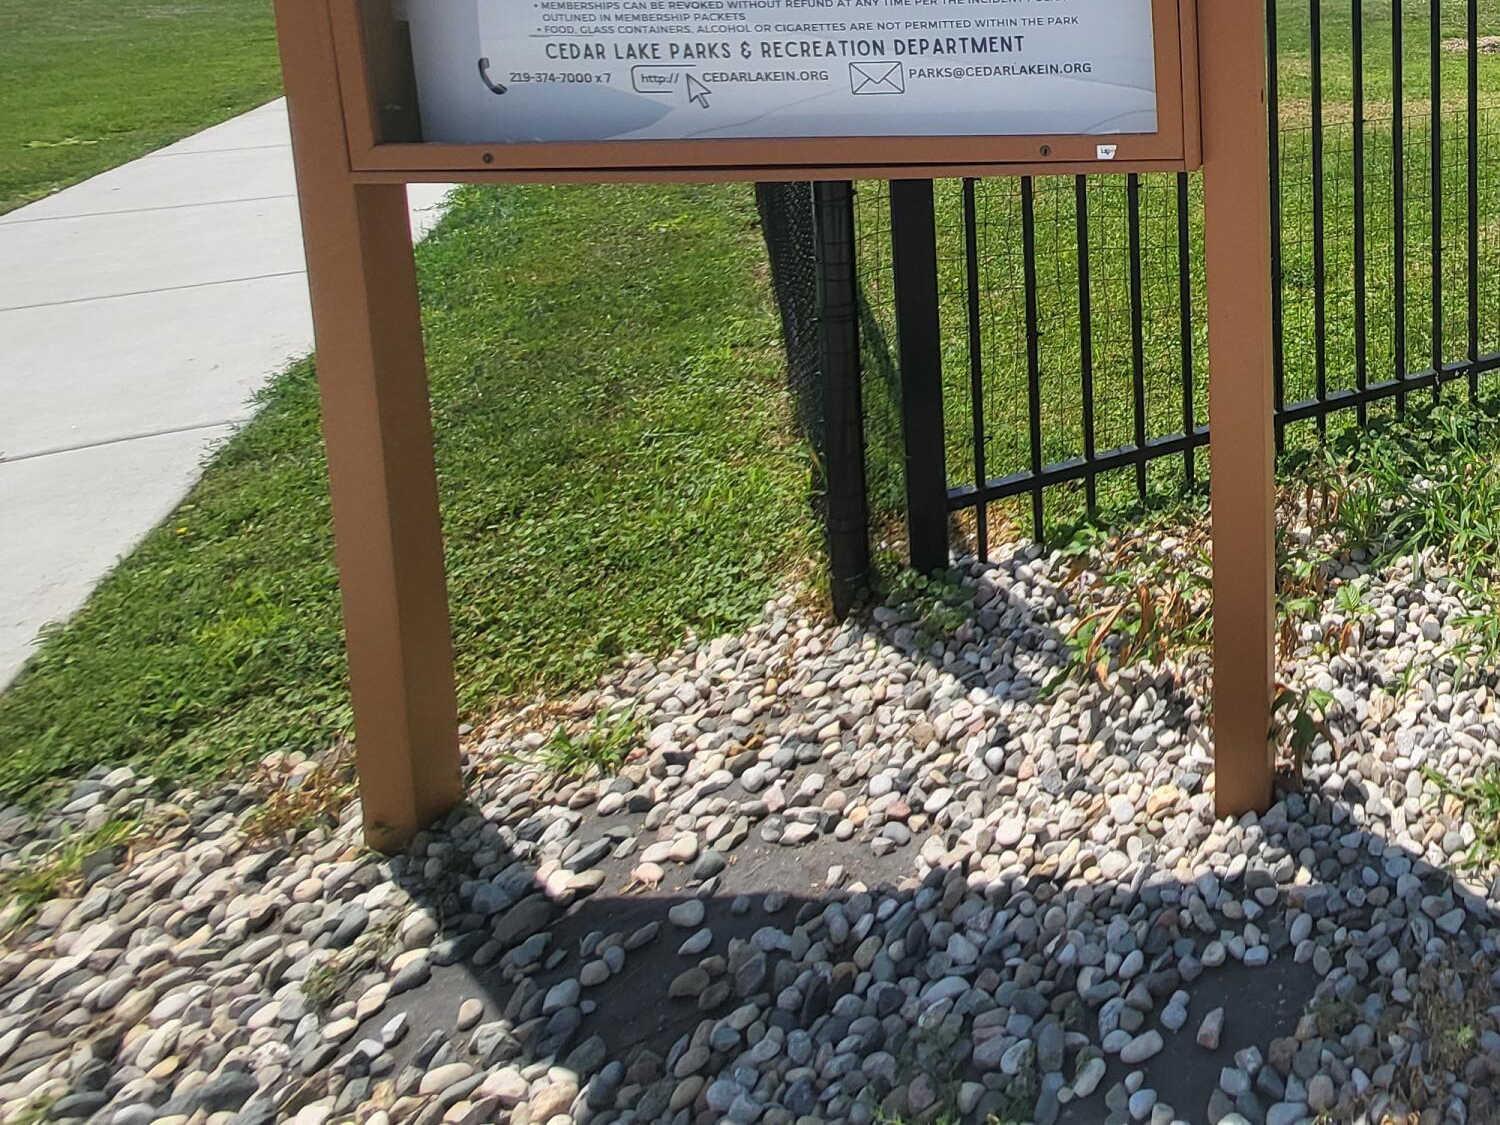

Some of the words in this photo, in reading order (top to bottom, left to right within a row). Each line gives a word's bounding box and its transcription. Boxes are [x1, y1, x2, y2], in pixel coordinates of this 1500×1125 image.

[541, 1, 621, 10] MEMBERSHIPS
[622, 2, 647, 10] CAN
[650, 1, 666, 10] BE
[668, 0, 724, 10] REVOKED
[727, 0, 780, 9] WITHOUT
[785, 0, 834, 9] REFUND
[545, 42, 606, 60] CEDAR
[614, 42, 662, 60] LAKE
[669, 42, 731, 59] PARKS
[740, 41, 752, 59] &
[760, 39, 885, 58] RECREATION
[894, 35, 1023, 56] DEPARTMENT
[509, 72, 593, 83] 219-374-7000
[702, 70, 829, 84] CEDARLAKEIN.ORG
[909, 63, 1092, 80] PARKS@CEDARLAKEIN.ORG
